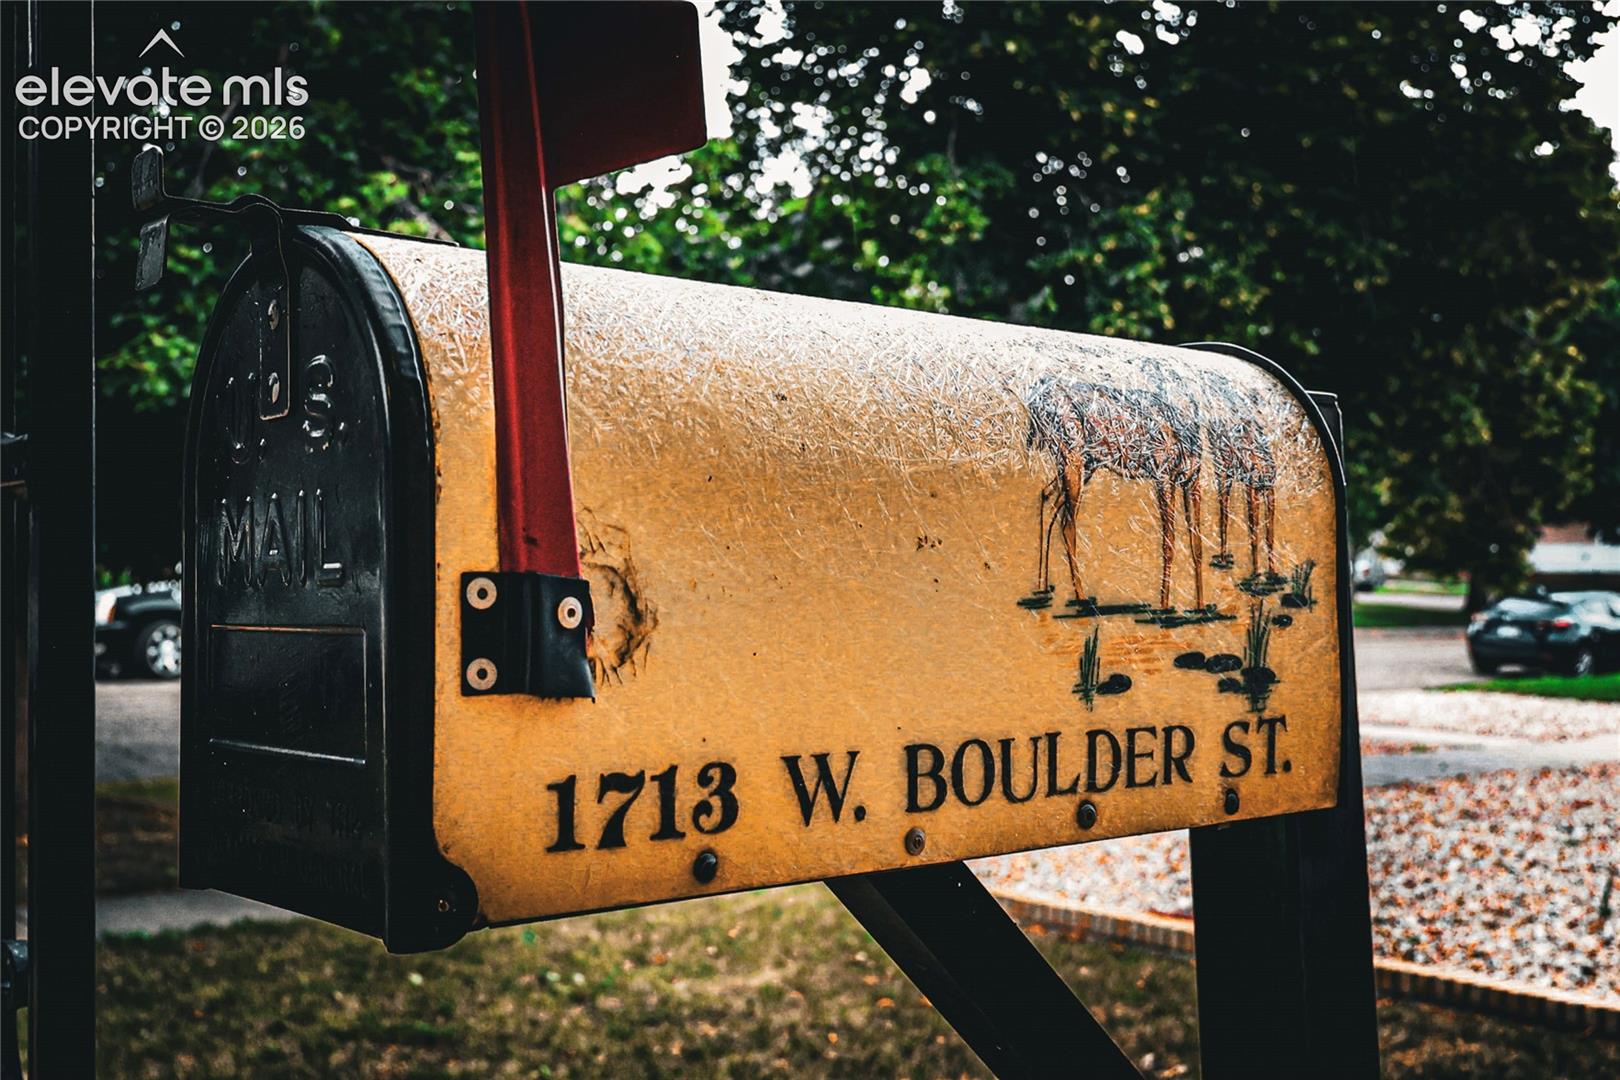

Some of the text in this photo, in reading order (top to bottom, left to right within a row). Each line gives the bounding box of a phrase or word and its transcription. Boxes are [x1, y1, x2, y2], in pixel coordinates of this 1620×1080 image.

[213, 488, 344, 588] MAIL
[545, 714, 1292, 854] 1713 W. BOULDER ST.
